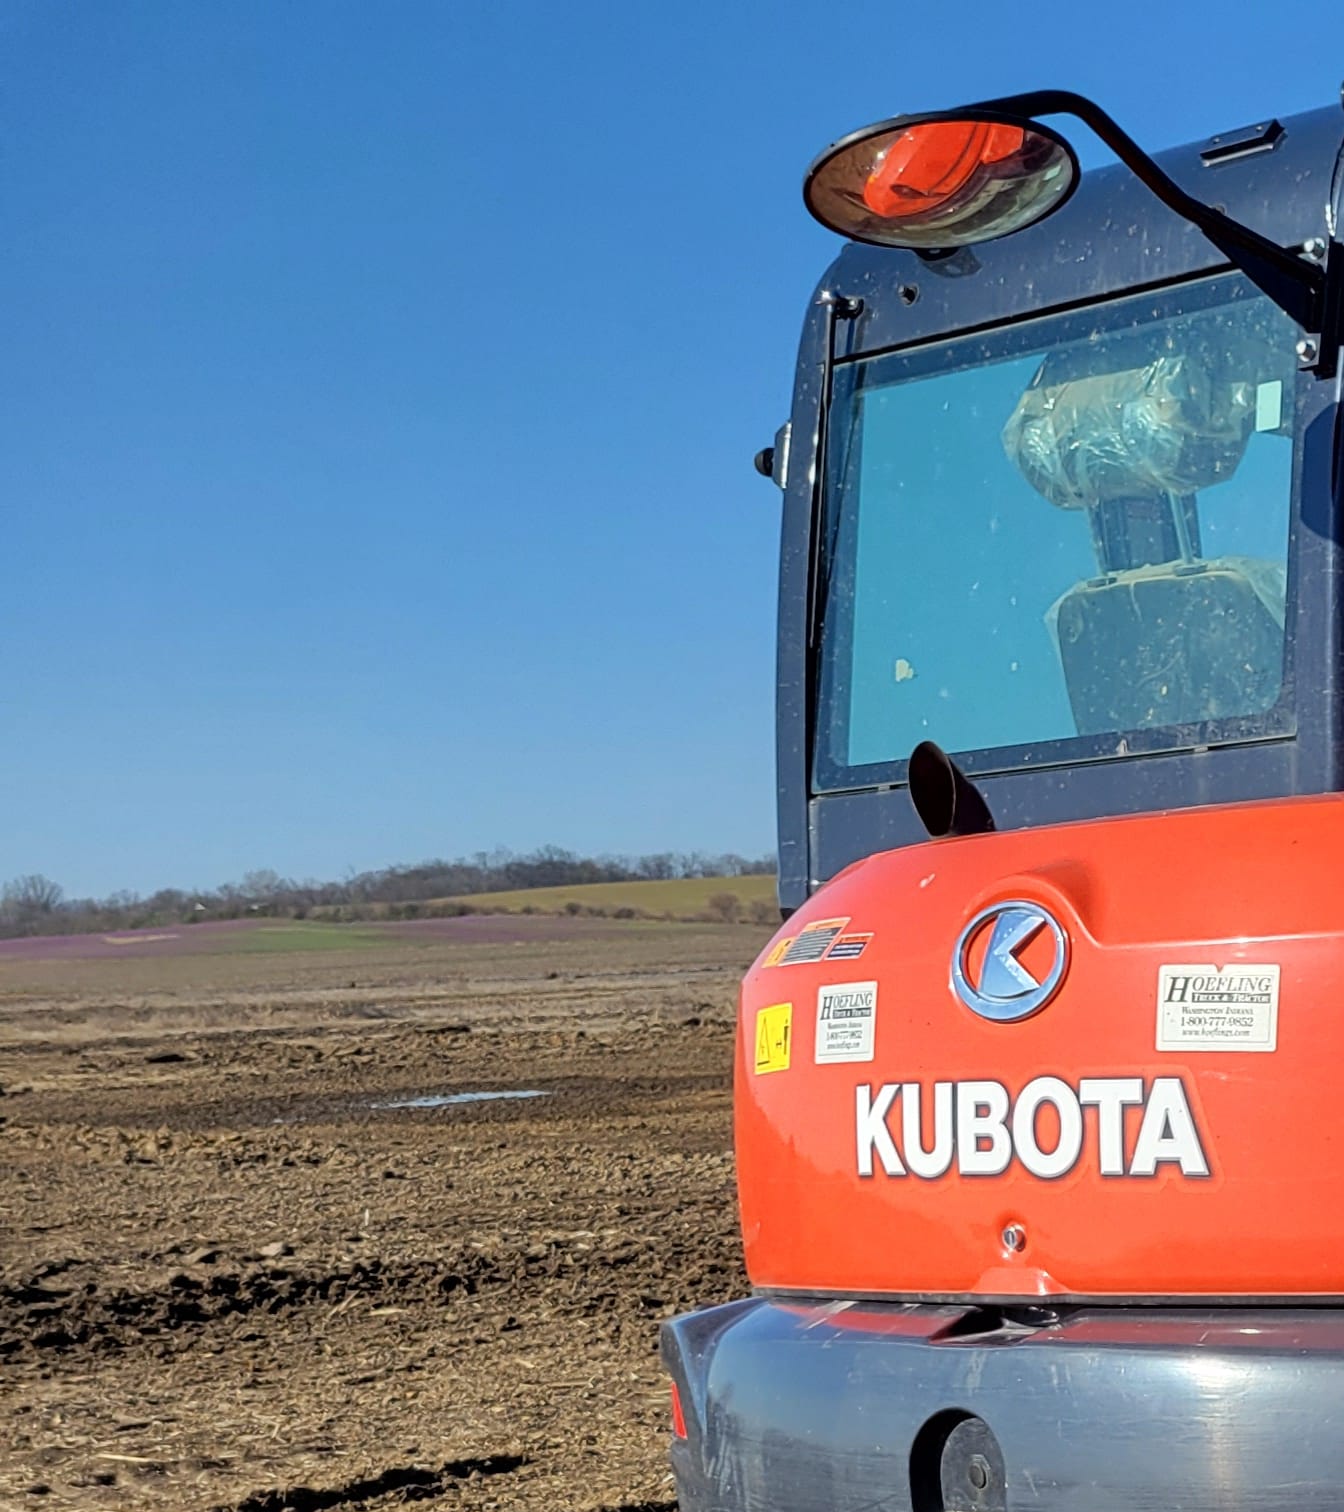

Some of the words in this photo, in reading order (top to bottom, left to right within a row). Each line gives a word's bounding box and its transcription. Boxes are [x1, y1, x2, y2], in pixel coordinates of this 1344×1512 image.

[1163, 976, 1272, 1003] HOEFLING
[820, 992, 873, 1020] HOEFLING
[1180, 1016, 1254, 1027] 1-800-777-9852
[855, 1076, 1211, 1178] KUBOTA
